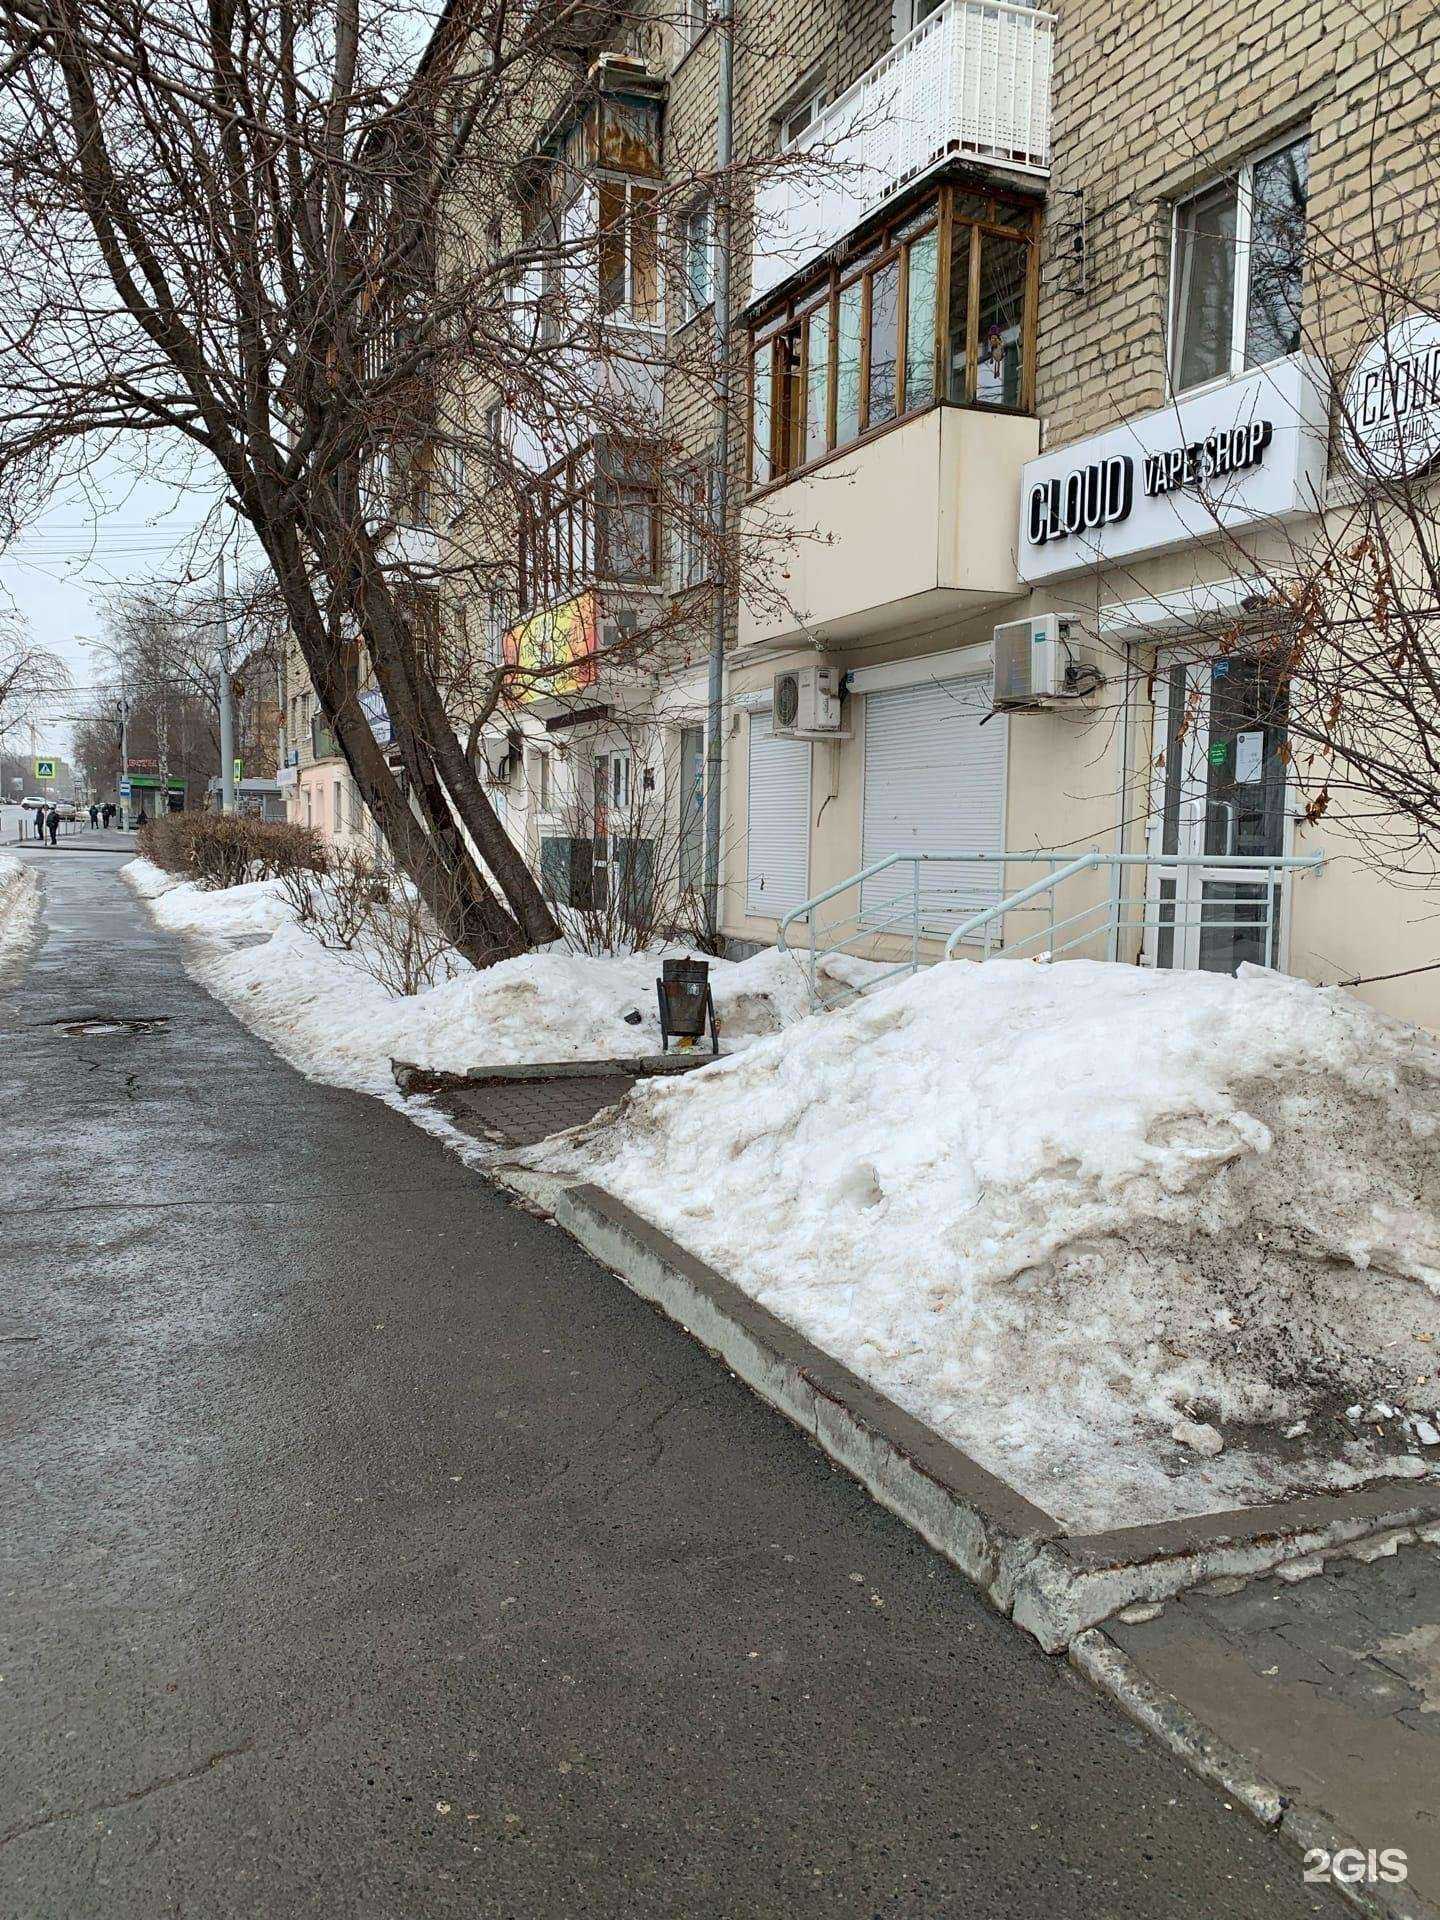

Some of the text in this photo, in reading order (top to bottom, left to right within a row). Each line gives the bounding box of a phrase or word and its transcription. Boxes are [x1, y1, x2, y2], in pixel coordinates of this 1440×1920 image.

[1027, 420, 1272, 545] CLOUD VAPE SHOP
